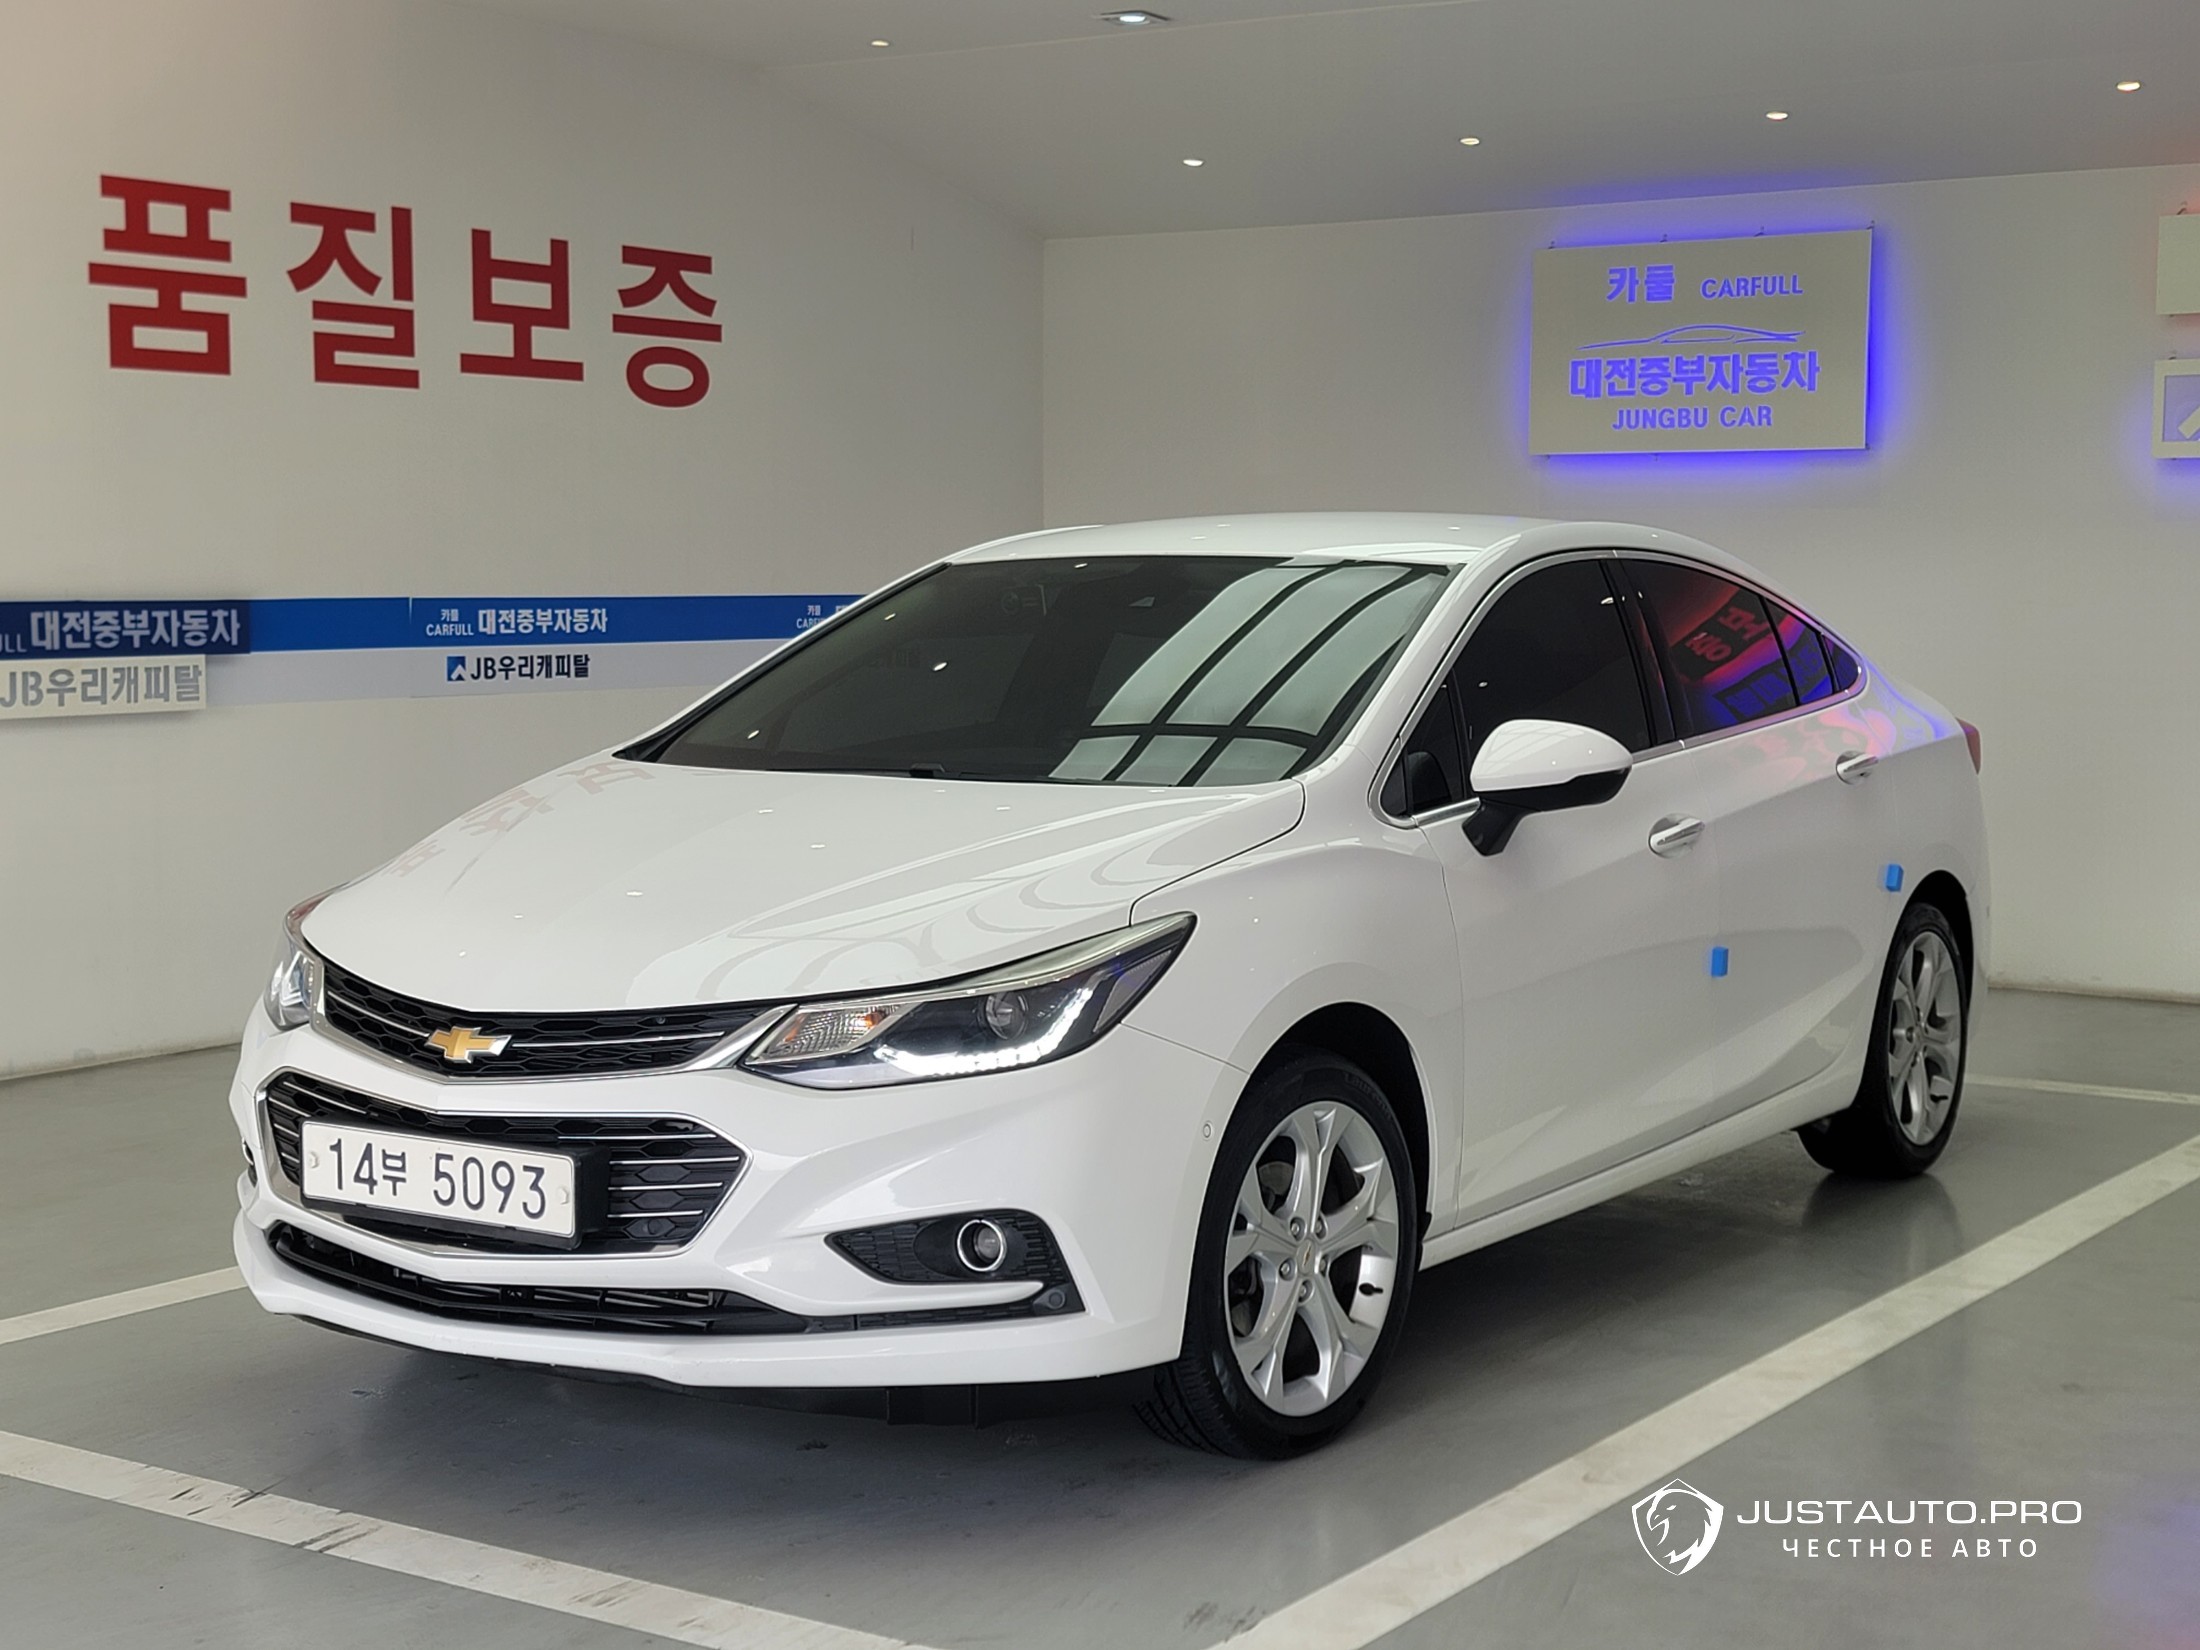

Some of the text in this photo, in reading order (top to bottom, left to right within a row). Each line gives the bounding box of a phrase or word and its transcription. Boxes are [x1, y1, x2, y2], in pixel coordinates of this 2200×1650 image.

[88, 174, 722, 408] 품질보증
[1701, 275, 1803, 299] CARFULL
[1569, 351, 1820, 398] 대전중부자동차
[1612, 406, 1773, 430] JUNGBU CAR
[30, 609, 240, 650] 대전중부자동차
[426, 624, 474, 636] CARFULL
[478, 608, 608, 634] 대전중부자동차
[470, 654, 590, 681] JB우리캐피탈
[0, 665, 202, 708] JB우리캐피탈
[329, 1138, 546, 1219] 14부 5093
